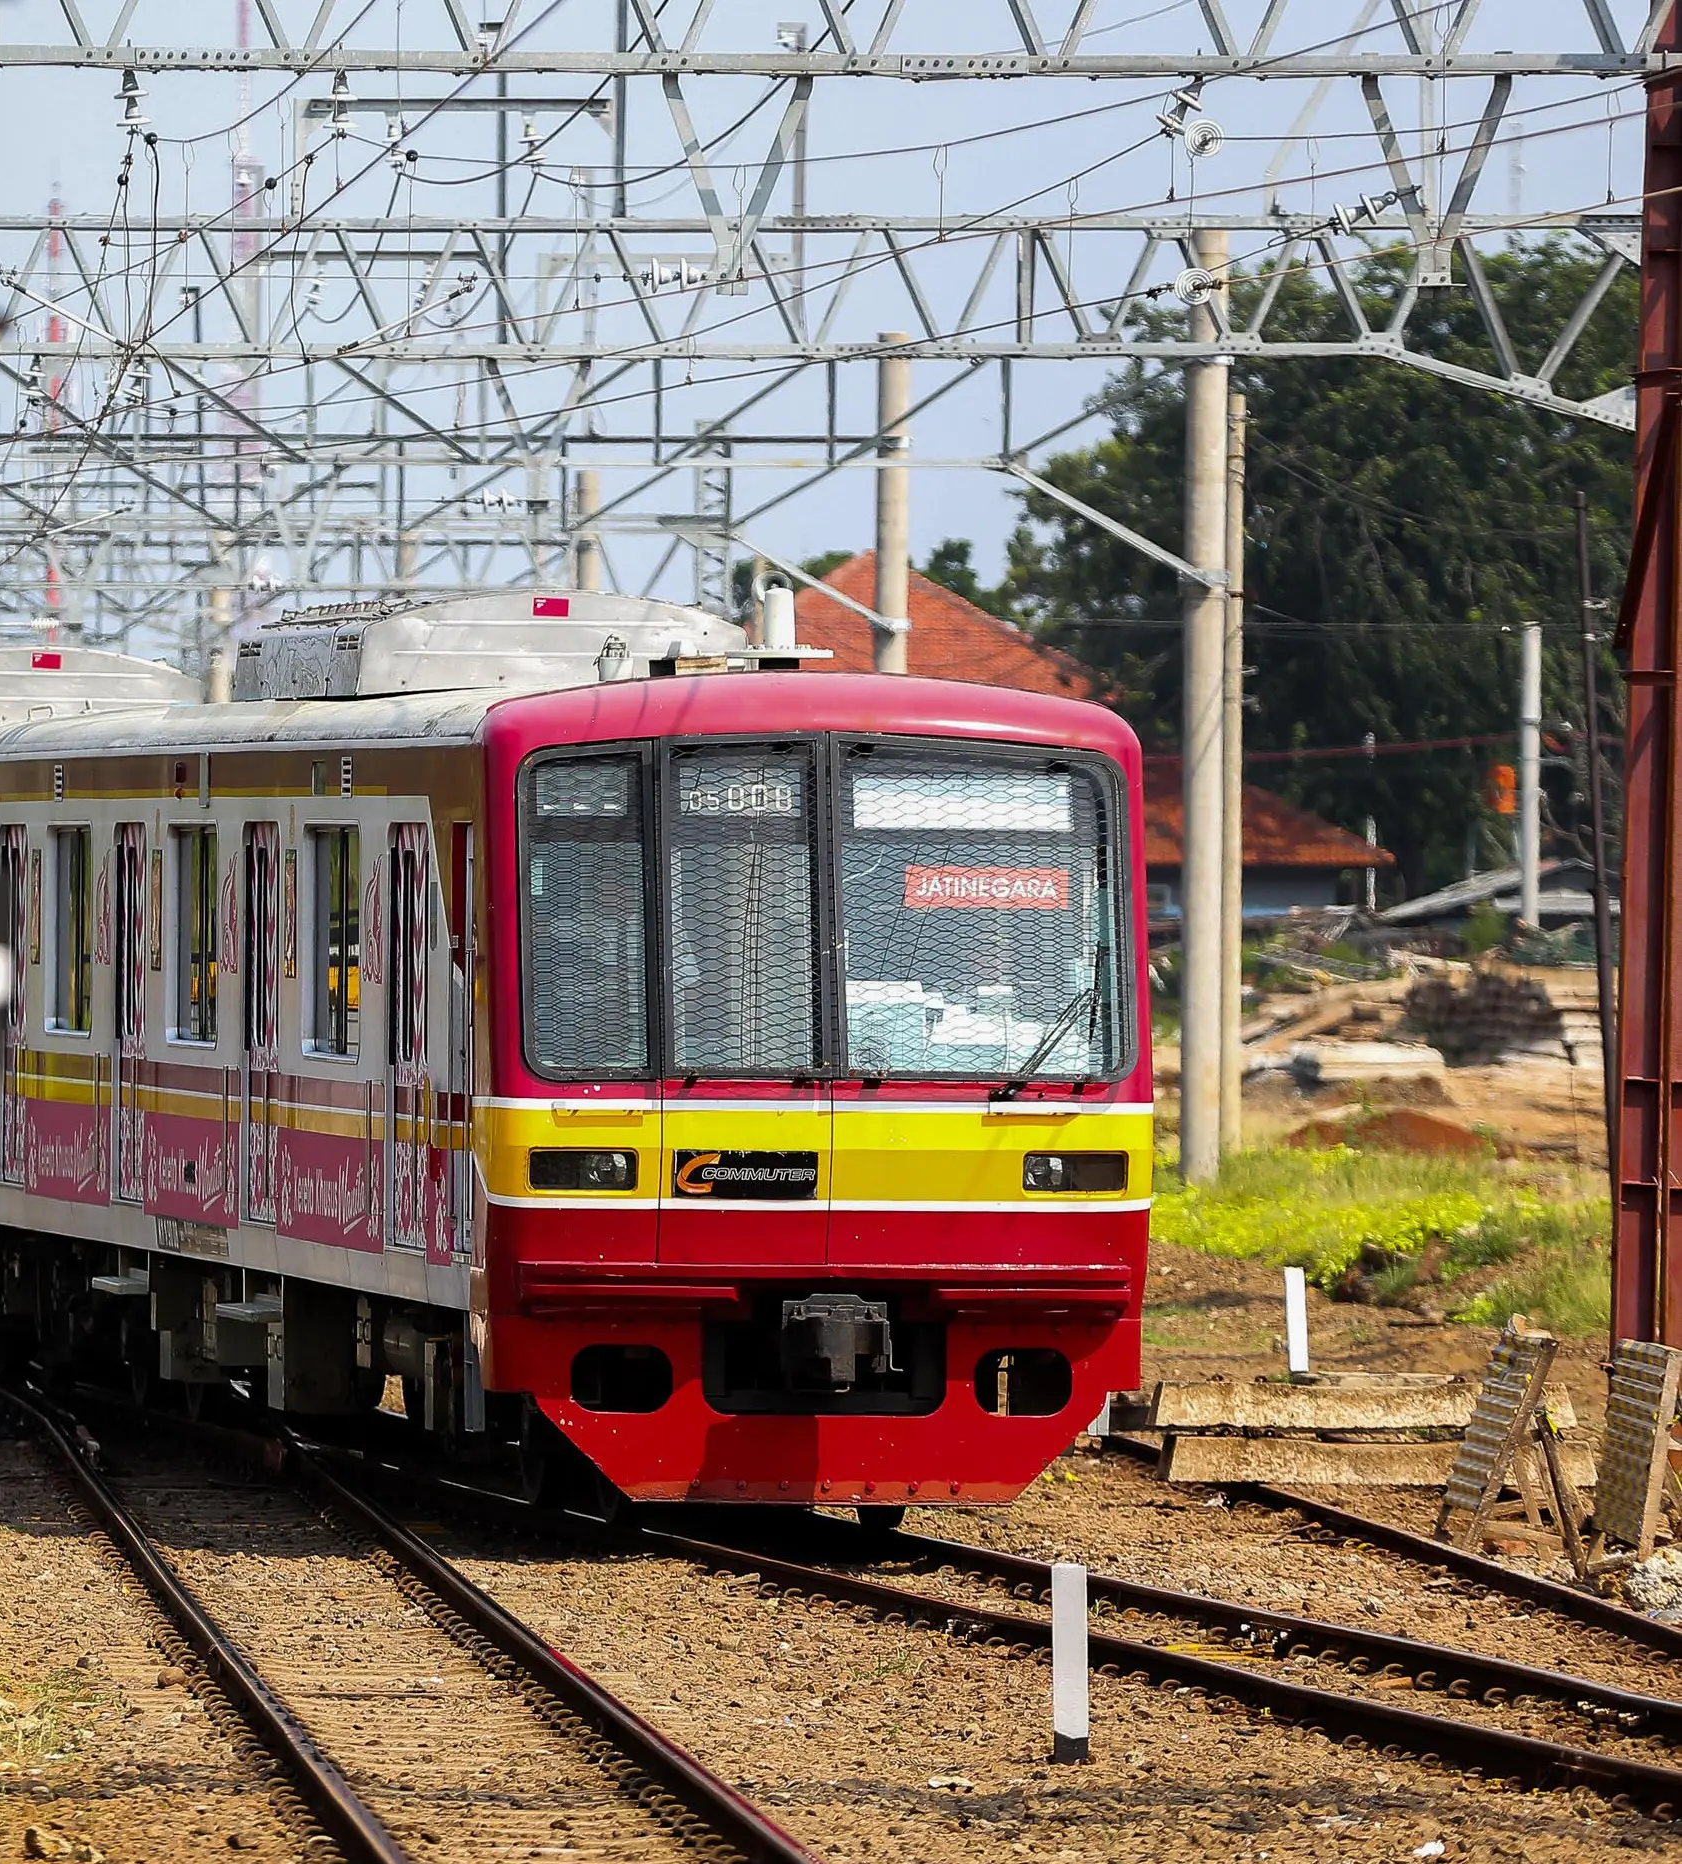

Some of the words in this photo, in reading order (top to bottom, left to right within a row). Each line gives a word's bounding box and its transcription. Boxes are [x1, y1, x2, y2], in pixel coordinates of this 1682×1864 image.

[915, 876, 1058, 899] JATINEGARA
[702, 1167, 816, 1181] COMMUTER
[293, 1164, 314, 1215] Kereta
[315, 1167, 338, 1218] Khusus
